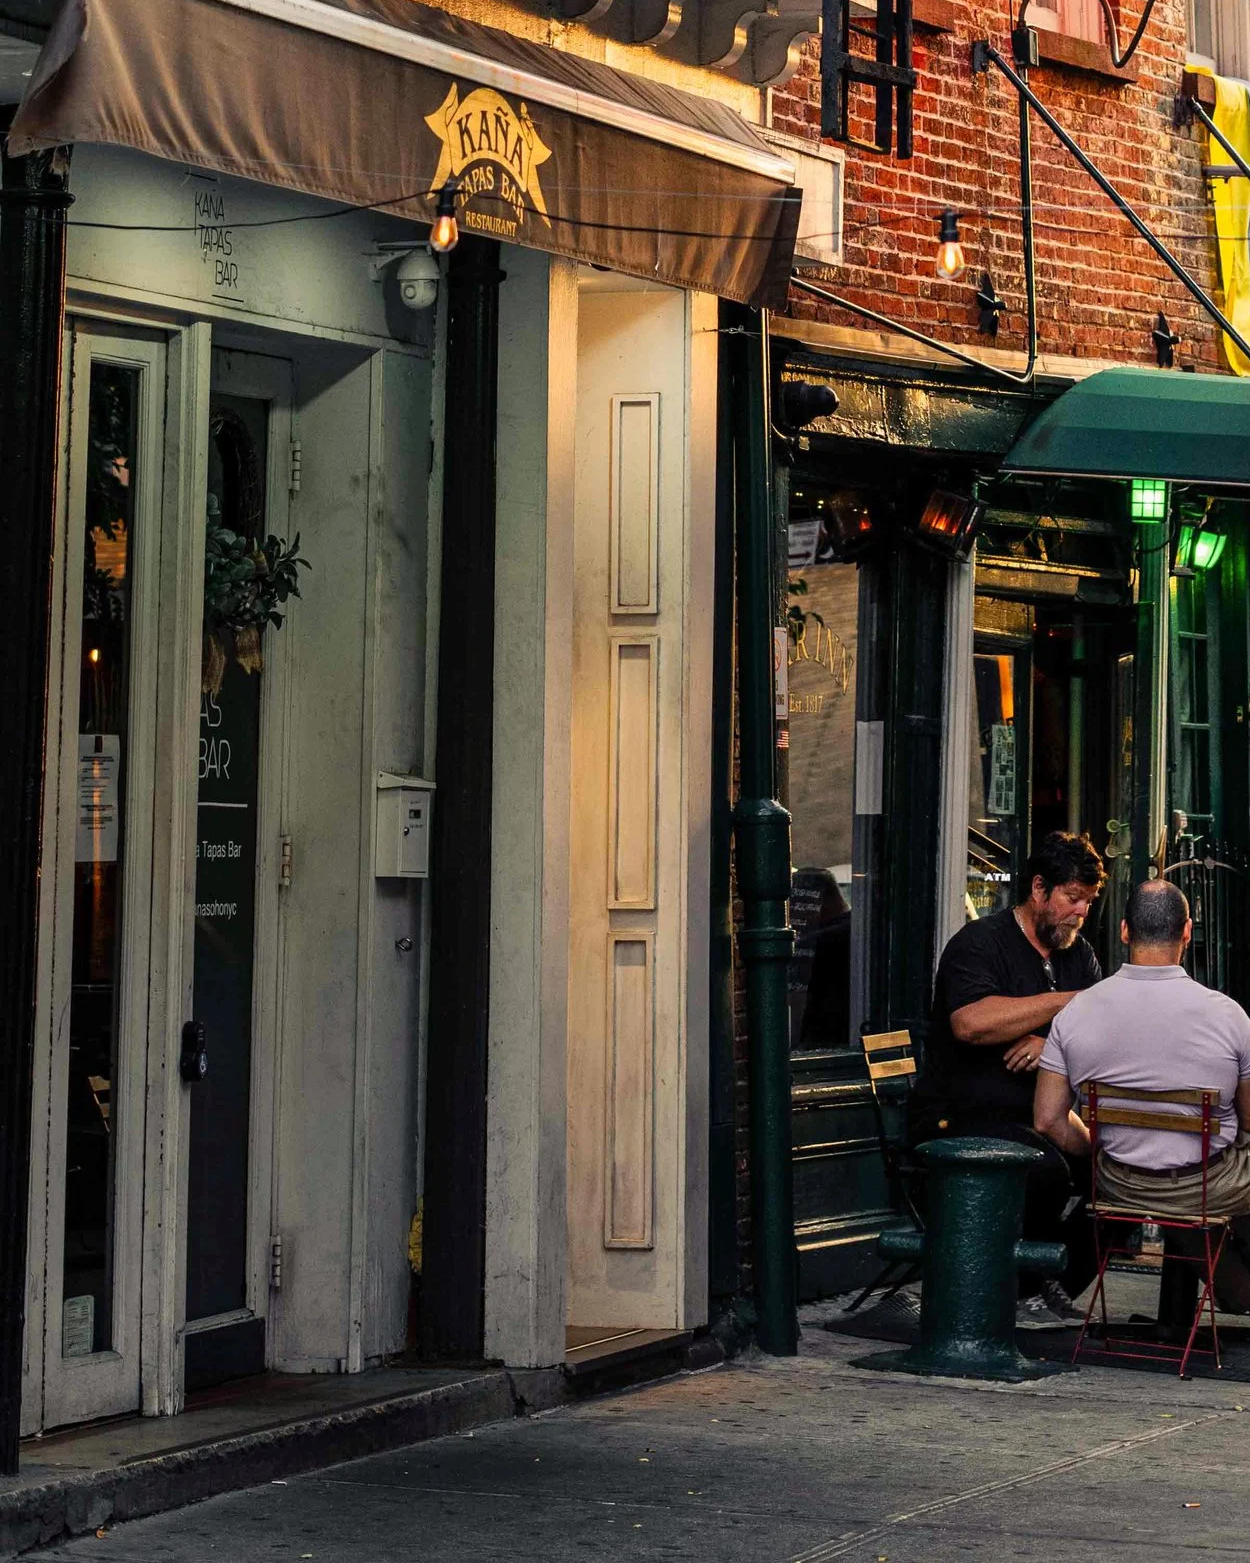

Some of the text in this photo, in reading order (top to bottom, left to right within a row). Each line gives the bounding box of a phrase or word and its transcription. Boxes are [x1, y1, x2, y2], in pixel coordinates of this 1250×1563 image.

[456, 106, 524, 176] KAÑA
[457, 166, 495, 207] TAPAS
[465, 210, 517, 237] RESTAURANT
[198, 224, 233, 256] TAPAS
[215, 259, 239, 289] BAR
[199, 736, 231, 780] BAR
[202, 840, 226, 862] Tapas
[228, 840, 242, 858] Bar
[984, 872, 1011, 882] ATM
[196, 899, 237, 920] nasohonyc
